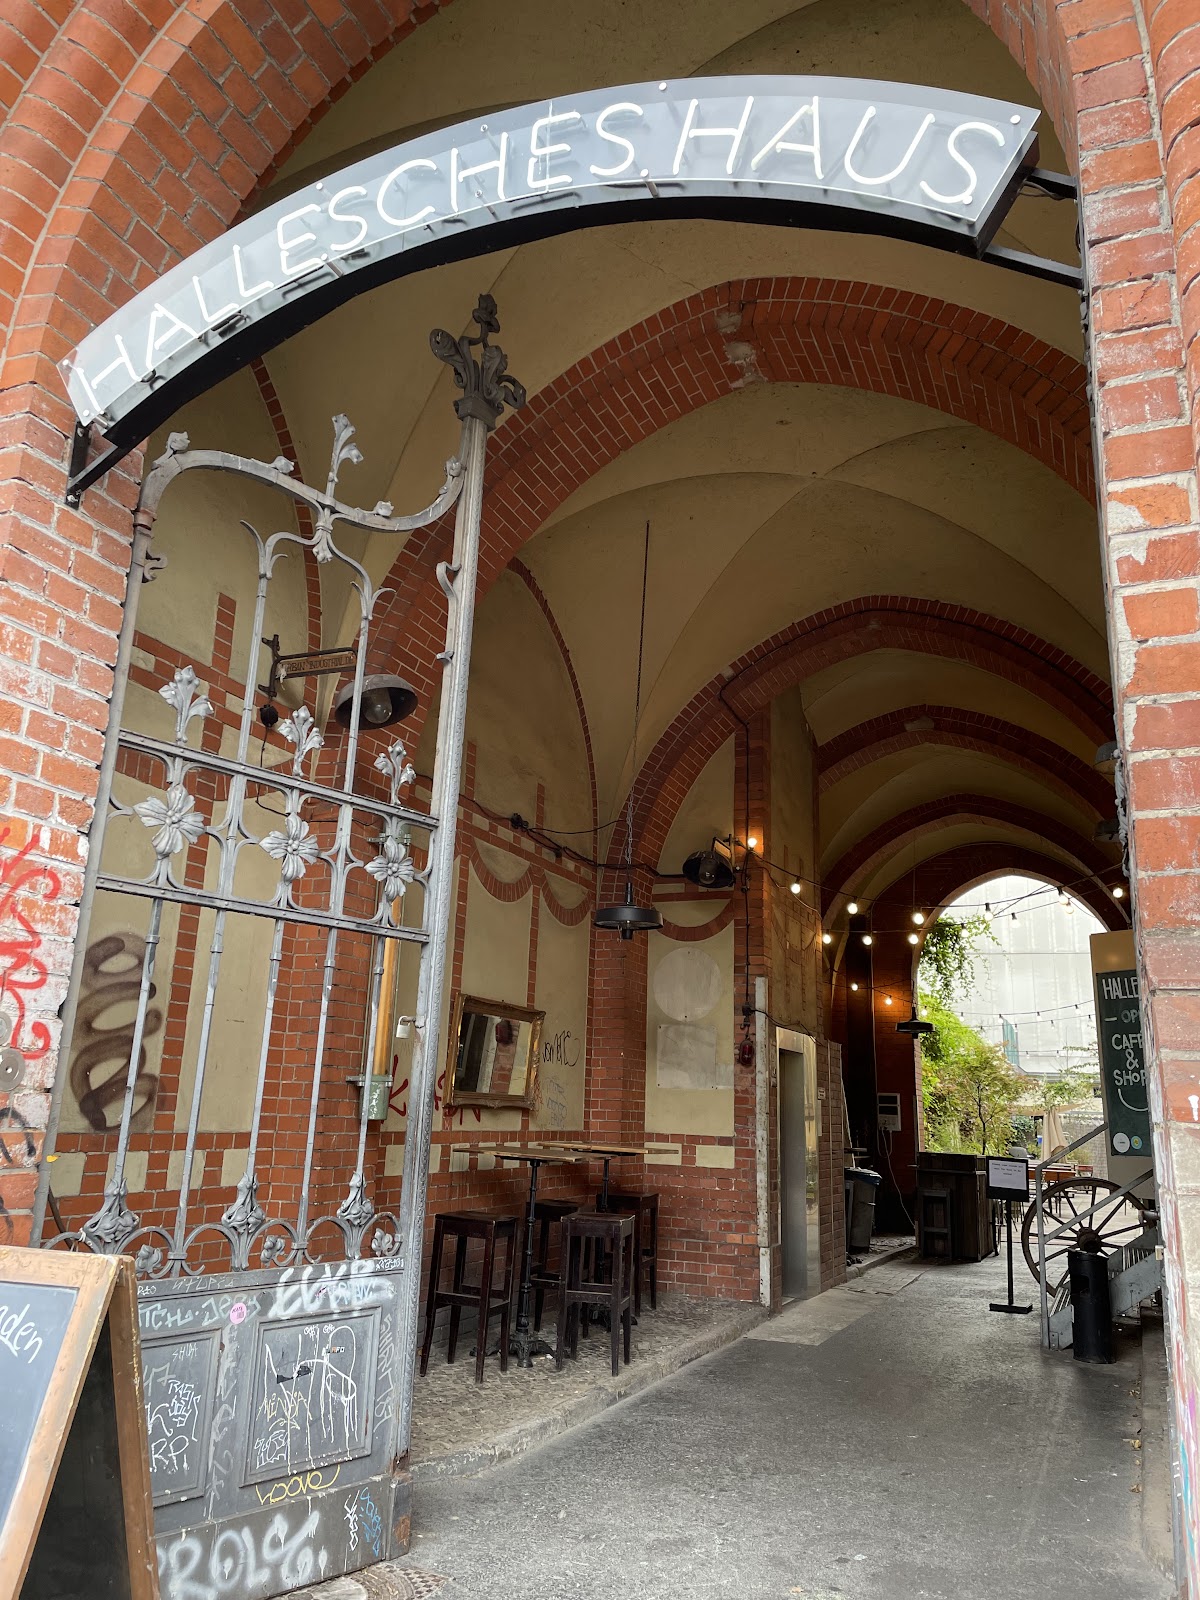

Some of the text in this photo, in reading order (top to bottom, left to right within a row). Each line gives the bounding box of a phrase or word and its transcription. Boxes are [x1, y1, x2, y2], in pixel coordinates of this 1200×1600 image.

[73, 95, 1006, 416] HALLESCHES HAUS
[1125, 1048, 1139, 1070] &
